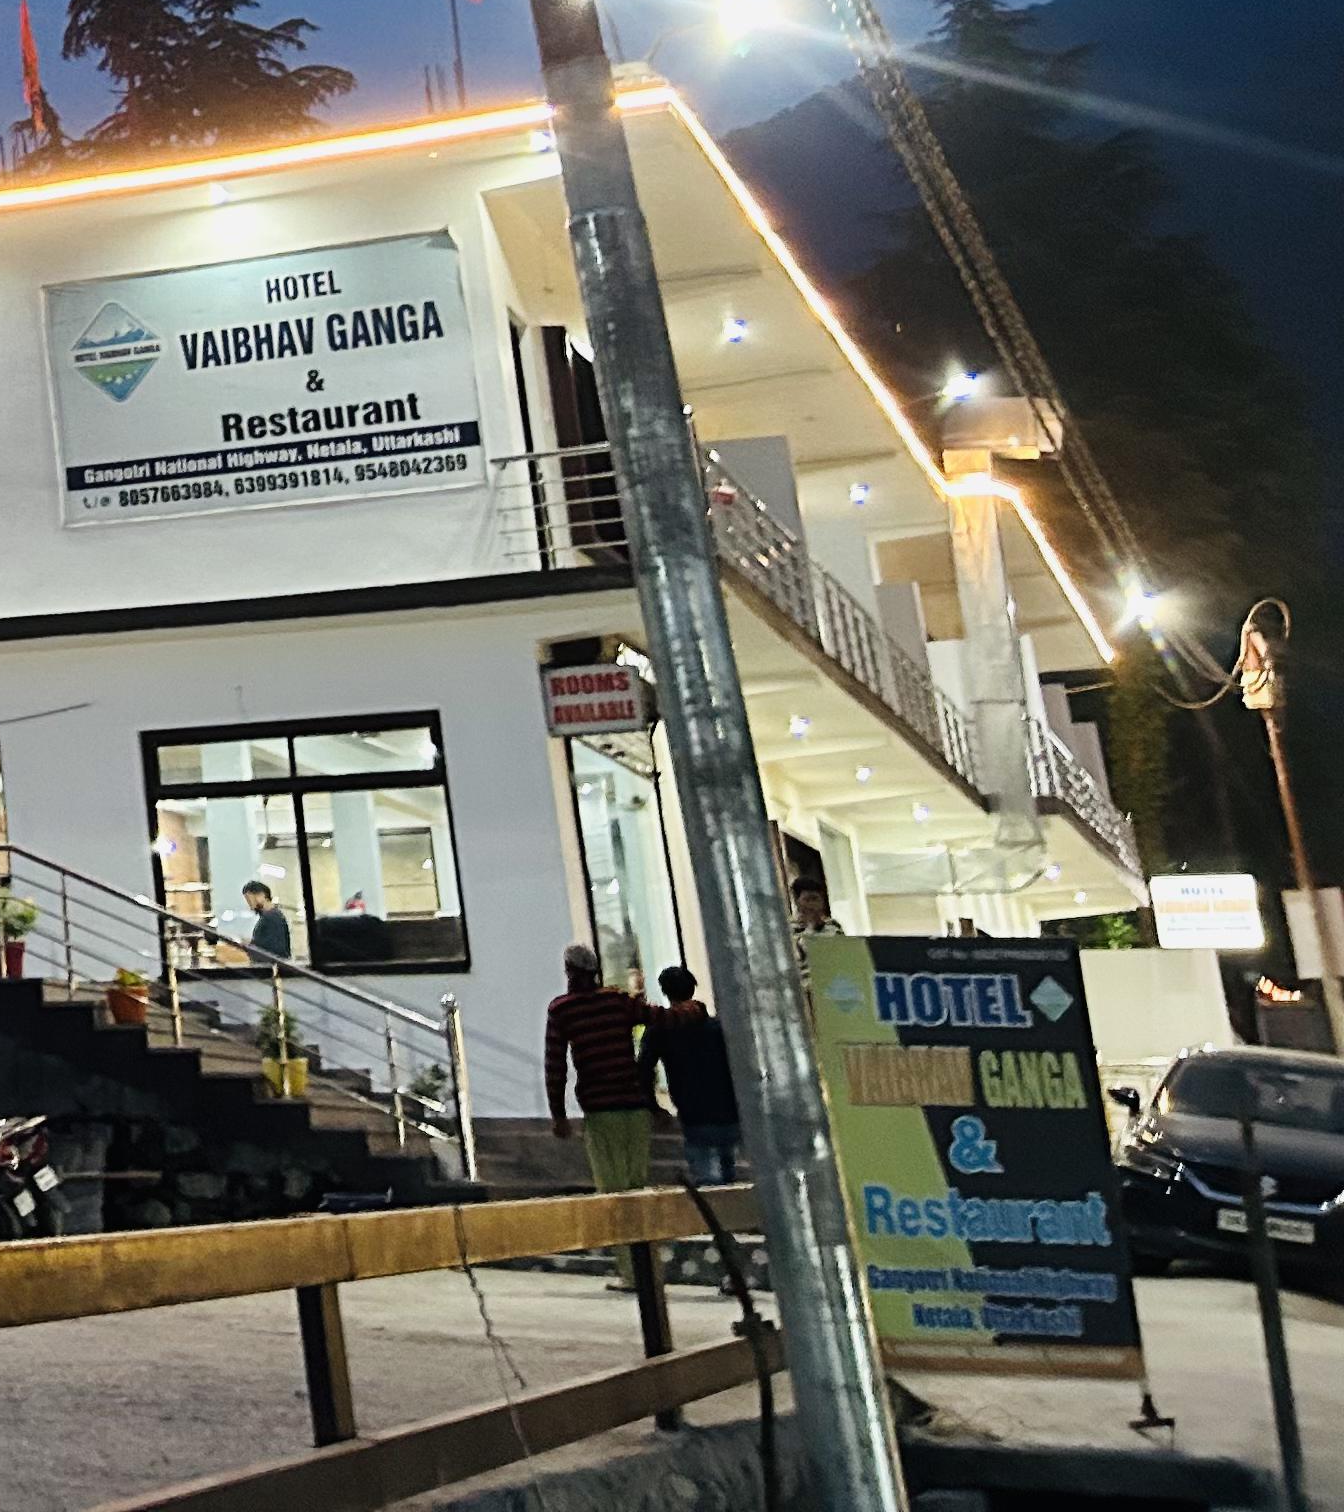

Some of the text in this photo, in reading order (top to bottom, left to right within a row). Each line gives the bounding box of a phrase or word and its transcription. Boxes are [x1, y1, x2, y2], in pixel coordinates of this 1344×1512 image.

[266, 270, 341, 304] HOTEL
[180, 301, 444, 370] VAIBHAV GANGA
[306, 369, 324, 392] &
[222, 393, 421, 442] Restaurant
[84, 465, 151, 484] Gangotri
[155, 455, 223, 476] National
[372, 426, 461, 452] Uttarkashi
[550, 671, 630, 696] ROOMS
[873, 971, 1034, 1028] HOTEL
[978, 1050, 1087, 1109] GANGA
[950, 1114, 1005, 1173] &
[863, 1185, 1112, 1246] Restaurant
